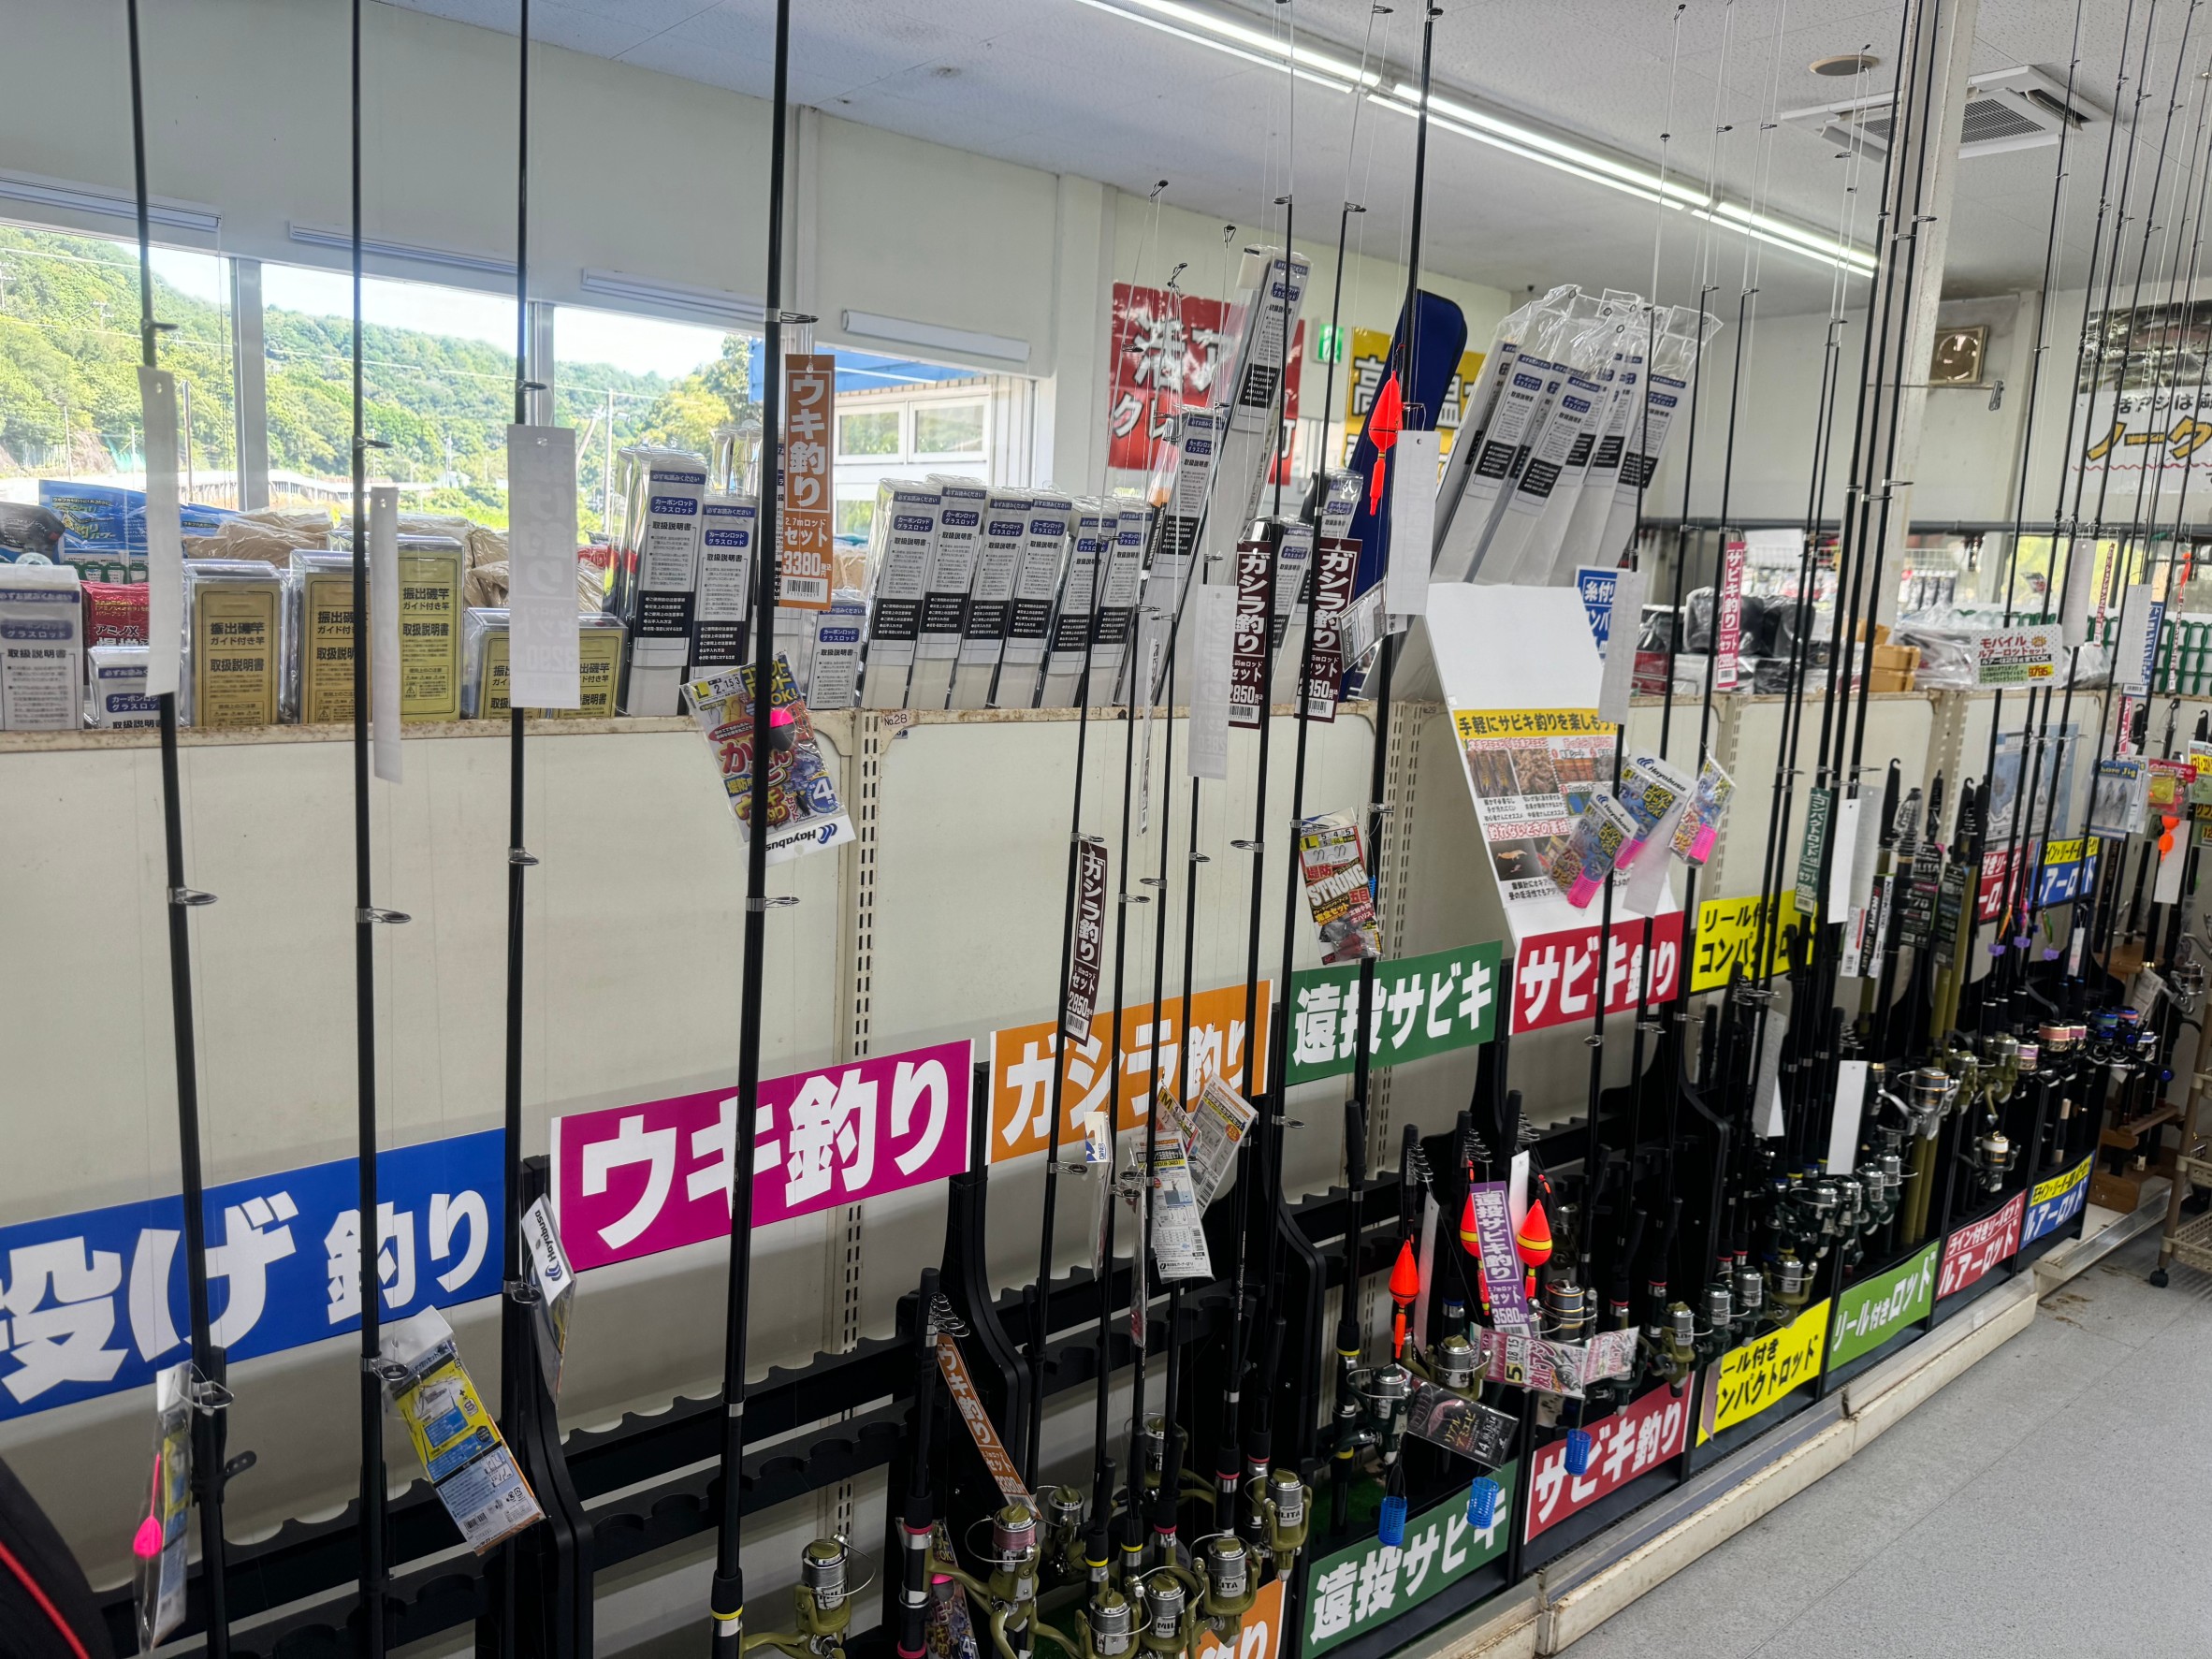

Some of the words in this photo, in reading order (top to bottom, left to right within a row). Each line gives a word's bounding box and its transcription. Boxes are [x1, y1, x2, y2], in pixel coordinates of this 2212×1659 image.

[790, 375, 825, 507] ウキ釣り
[652, 521, 691, 531] 取扱説明書
[785, 527, 828, 547] セット
[941, 531, 972, 540] 取扱説明書
[894, 537, 926, 546] 取扱説明書
[783, 551, 821, 576] 3380
[402, 587, 450, 600] 振出磯竿
[1314, 552, 1349, 648] ガシラ釣り
[1724, 552, 1741, 628] サビキ釣り
[403, 602, 449, 610] ガイド付き竿
[1235, 555, 1268, 652] ガシラ釣り
[96, 626, 139, 636] アミノX
[211, 622, 265, 634] 振出磯竿
[402, 622, 449, 636] 取扱説明書
[211, 636, 265, 646] ガイド付き竿
[1980, 636, 2027, 648] モバイル
[7, 648, 66, 659] 取扱説明書
[210, 658, 265, 672] 取扱説明書
[580, 662, 610, 674] 出磯竿
[111, 695, 158, 704] カーボンロッ
[112, 703, 157, 711] グラスロッ
[1649, 765, 1686, 793] Hayabusa
[765, 828, 816, 851] Hayabus
[1305, 864, 1333, 880] 堤防
[1306, 863, 1368, 908] STRONG
[1078, 855, 1103, 961] ガシラ釣り
[1071, 973, 1096, 996] セット
[1520, 936, 1677, 1025] サビキ釣り
[1067, 993, 1088, 1017] 2850
[1293, 960, 1492, 1067] 遠投サビキ
[1001, 1018, 1246, 1147] ガシラ釣り
[582, 1058, 949, 1250] ウキ釣り
[2023, 1176, 2088, 1242] ルアーロッド
[533, 1208, 559, 1265] Hayabusa
[1475, 1192, 1513, 1279] 遠投サビキ釣り
[1938, 1218, 2018, 1294] ルアーロッド
[1490, 1291, 1521, 1305] セット
[1832, 1250, 1938, 1353] リール付きロッド
[1492, 1307, 1520, 1325] 3580
[1720, 1337, 1780, 1379] ール付き
[1717, 1335, 1819, 1419] ンパクトロッド
[938, 1347, 992, 1444] ウキ釣り
[986, 1457, 1011, 1473] セット
[1535, 1401, 1682, 1524] サビキ釣り
[1311, 1489, 1507, 1646] 遠投サビキ
